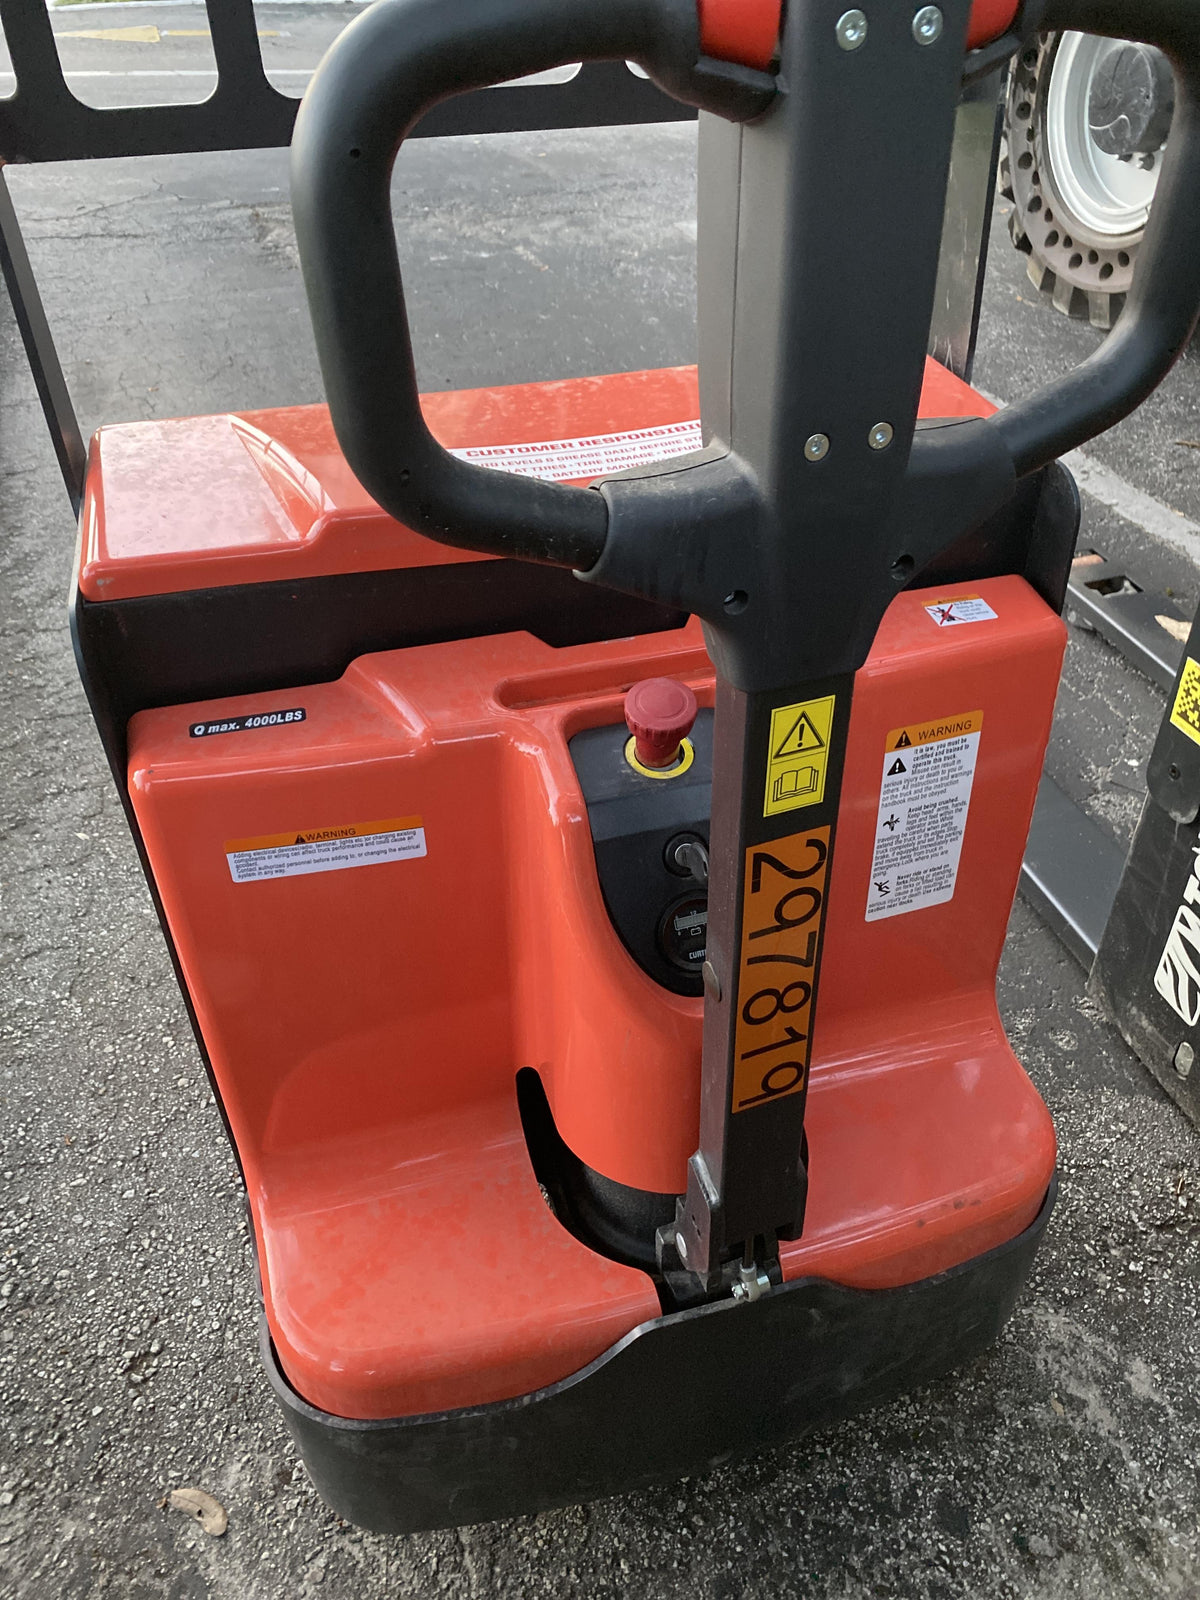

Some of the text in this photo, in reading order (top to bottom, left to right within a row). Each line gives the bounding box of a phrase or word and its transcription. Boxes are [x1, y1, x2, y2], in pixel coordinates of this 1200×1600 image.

[466, 442, 574, 457] CUSTOMER
[557, 452, 601, 462] GREASE
[604, 447, 636, 456] DAILY
[640, 439, 682, 450] BEFORE
[577, 459, 603, 467] TIRE
[606, 452, 655, 463] DAMAGE
[194, 710, 302, 735] Q max. 4000LBS
[918, 721, 972, 740] WARNING
[306, 828, 356, 841] WARNING
[738, 838, 827, 1107] 297819
